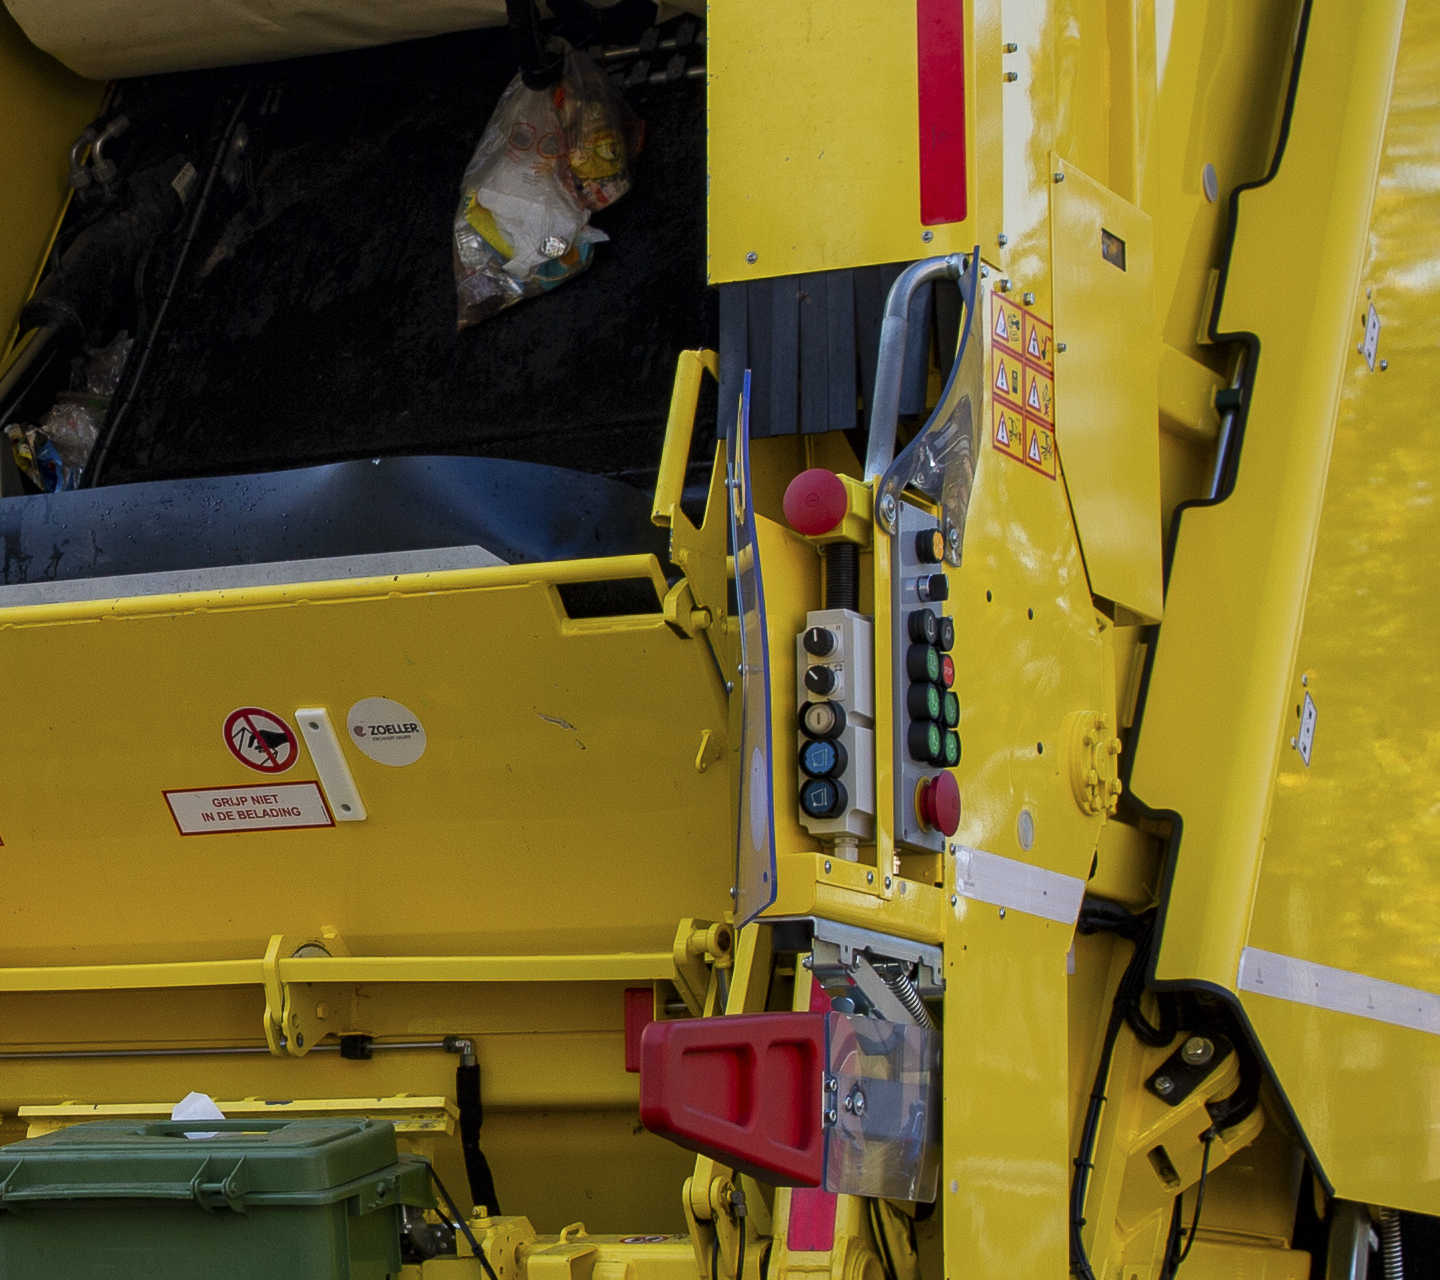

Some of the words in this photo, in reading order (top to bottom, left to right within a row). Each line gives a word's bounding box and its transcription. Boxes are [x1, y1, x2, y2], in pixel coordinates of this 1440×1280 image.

[368, 723, 420, 736] ZOELLER
[211, 796, 248, 808] GRIJP
[250, 794, 279, 806] NIET
[201, 812, 216, 822] IN
[217, 810, 235, 822] DE
[236, 806, 302, 820] BELADING
